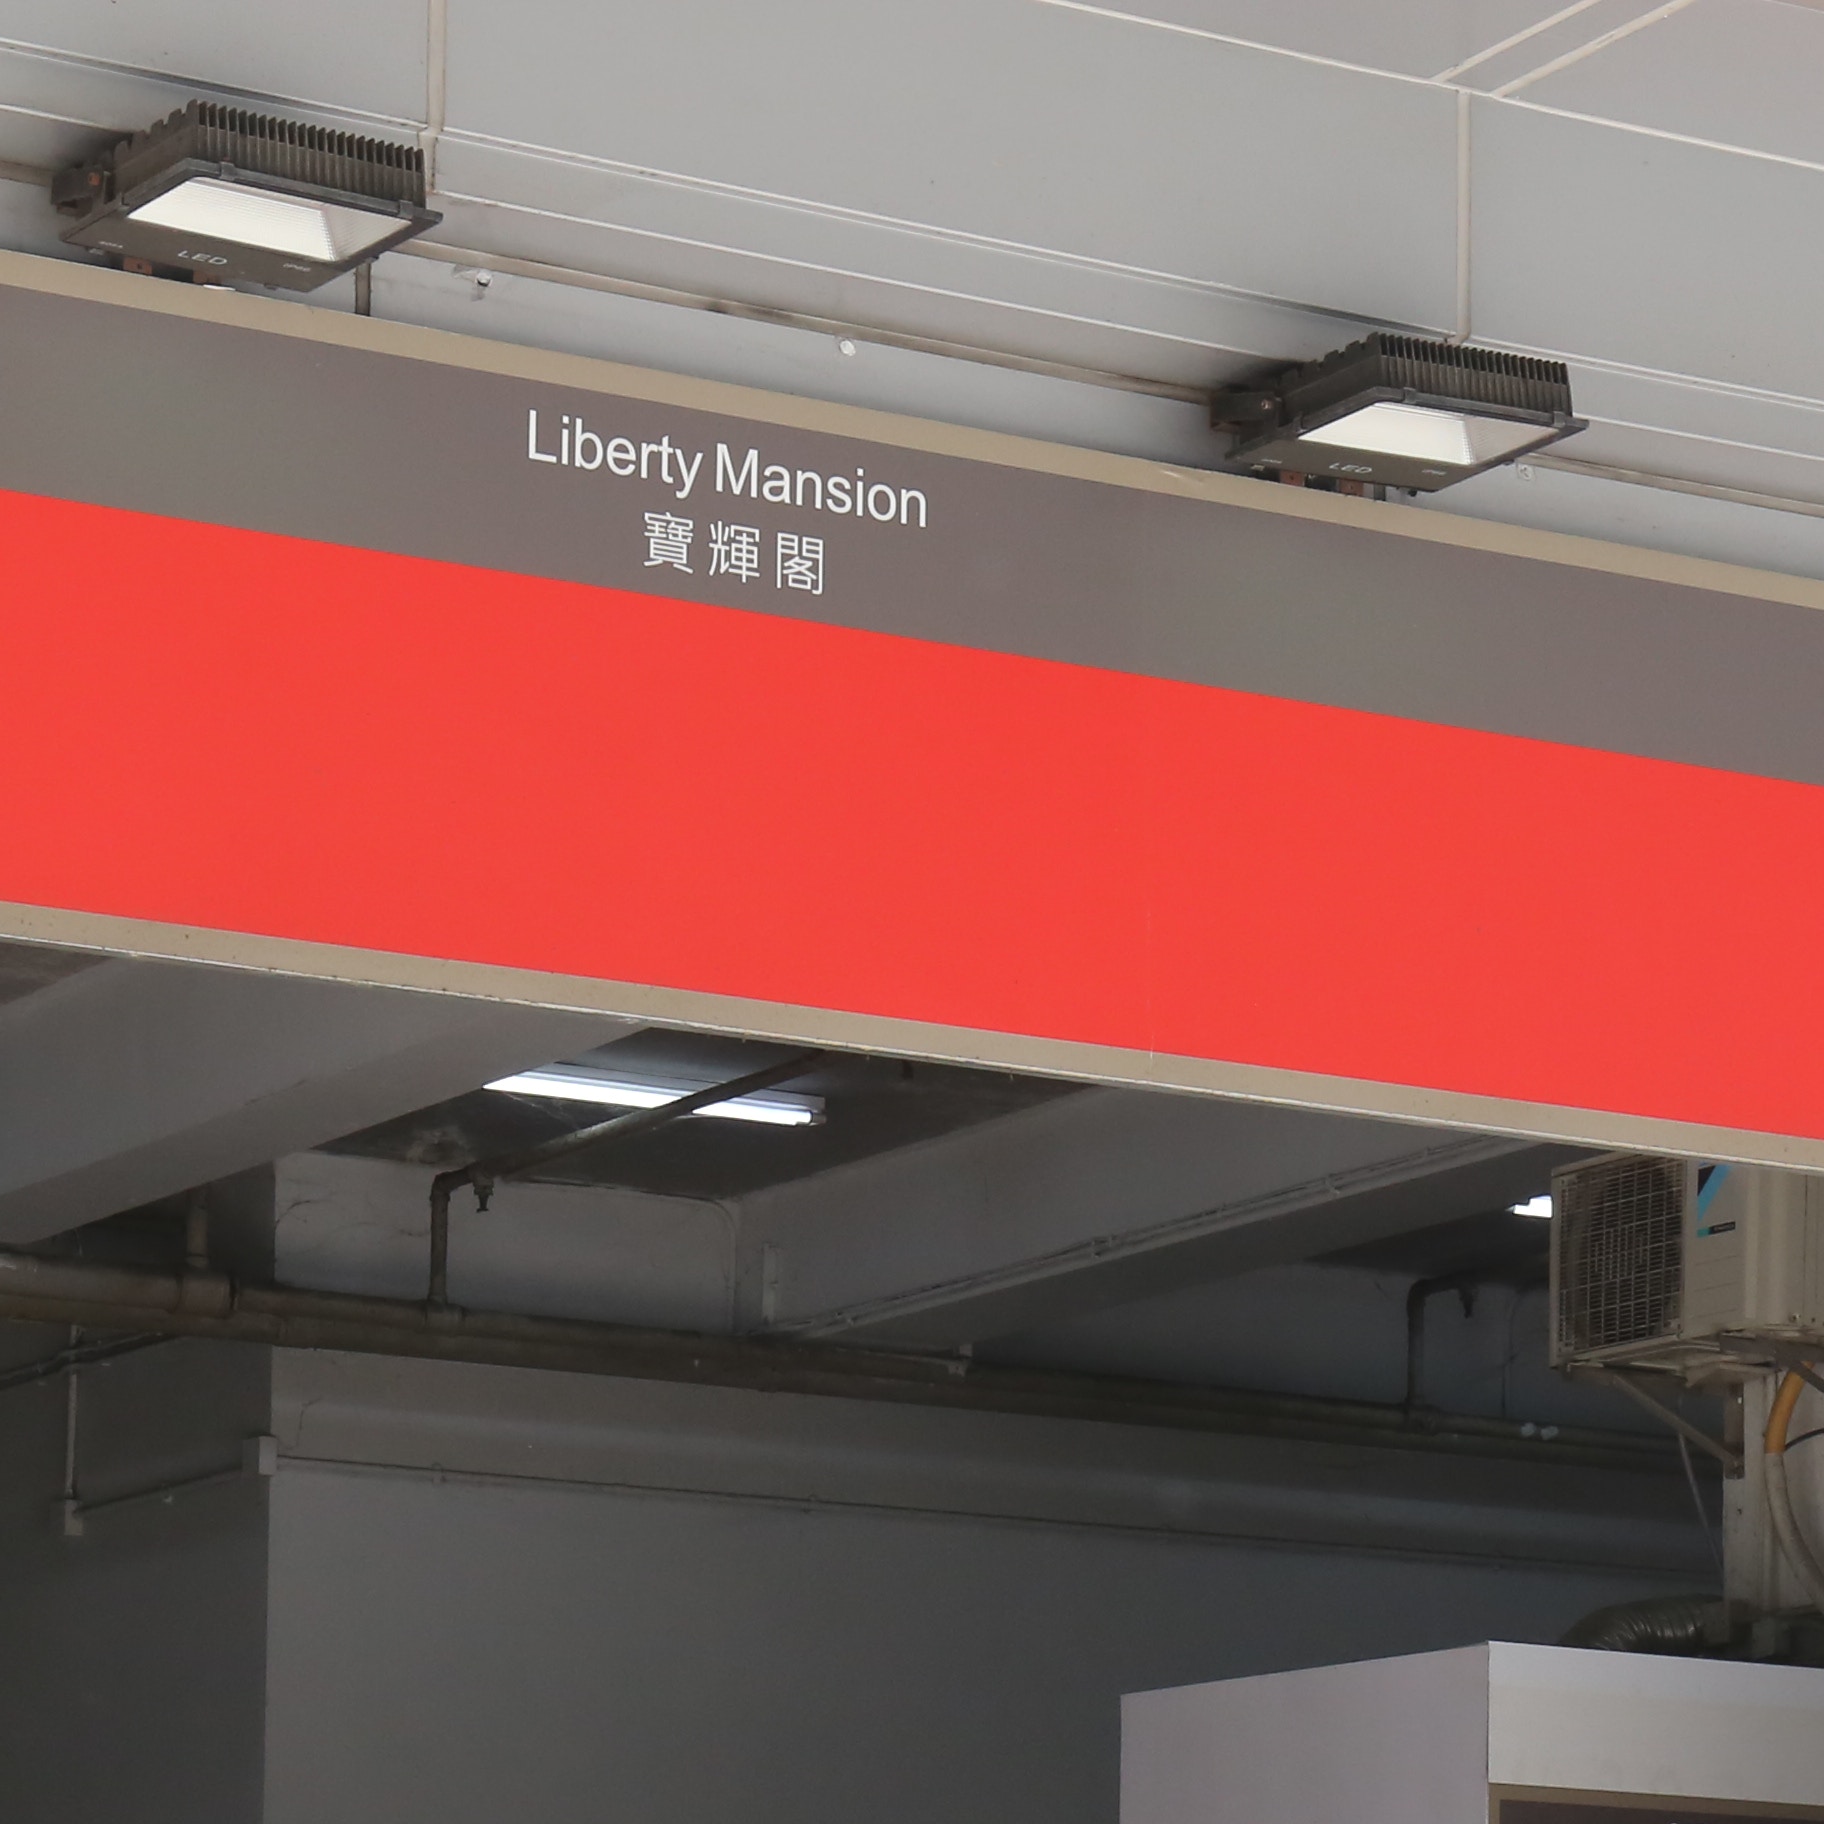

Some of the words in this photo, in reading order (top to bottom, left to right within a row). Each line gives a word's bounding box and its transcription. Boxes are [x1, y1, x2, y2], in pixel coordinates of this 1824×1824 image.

[177, 249, 228, 266] LED
[528, 409, 704, 499] Liberty
[715, 442, 928, 528] Mansion
[642, 511, 824, 595] 寶輝閣
